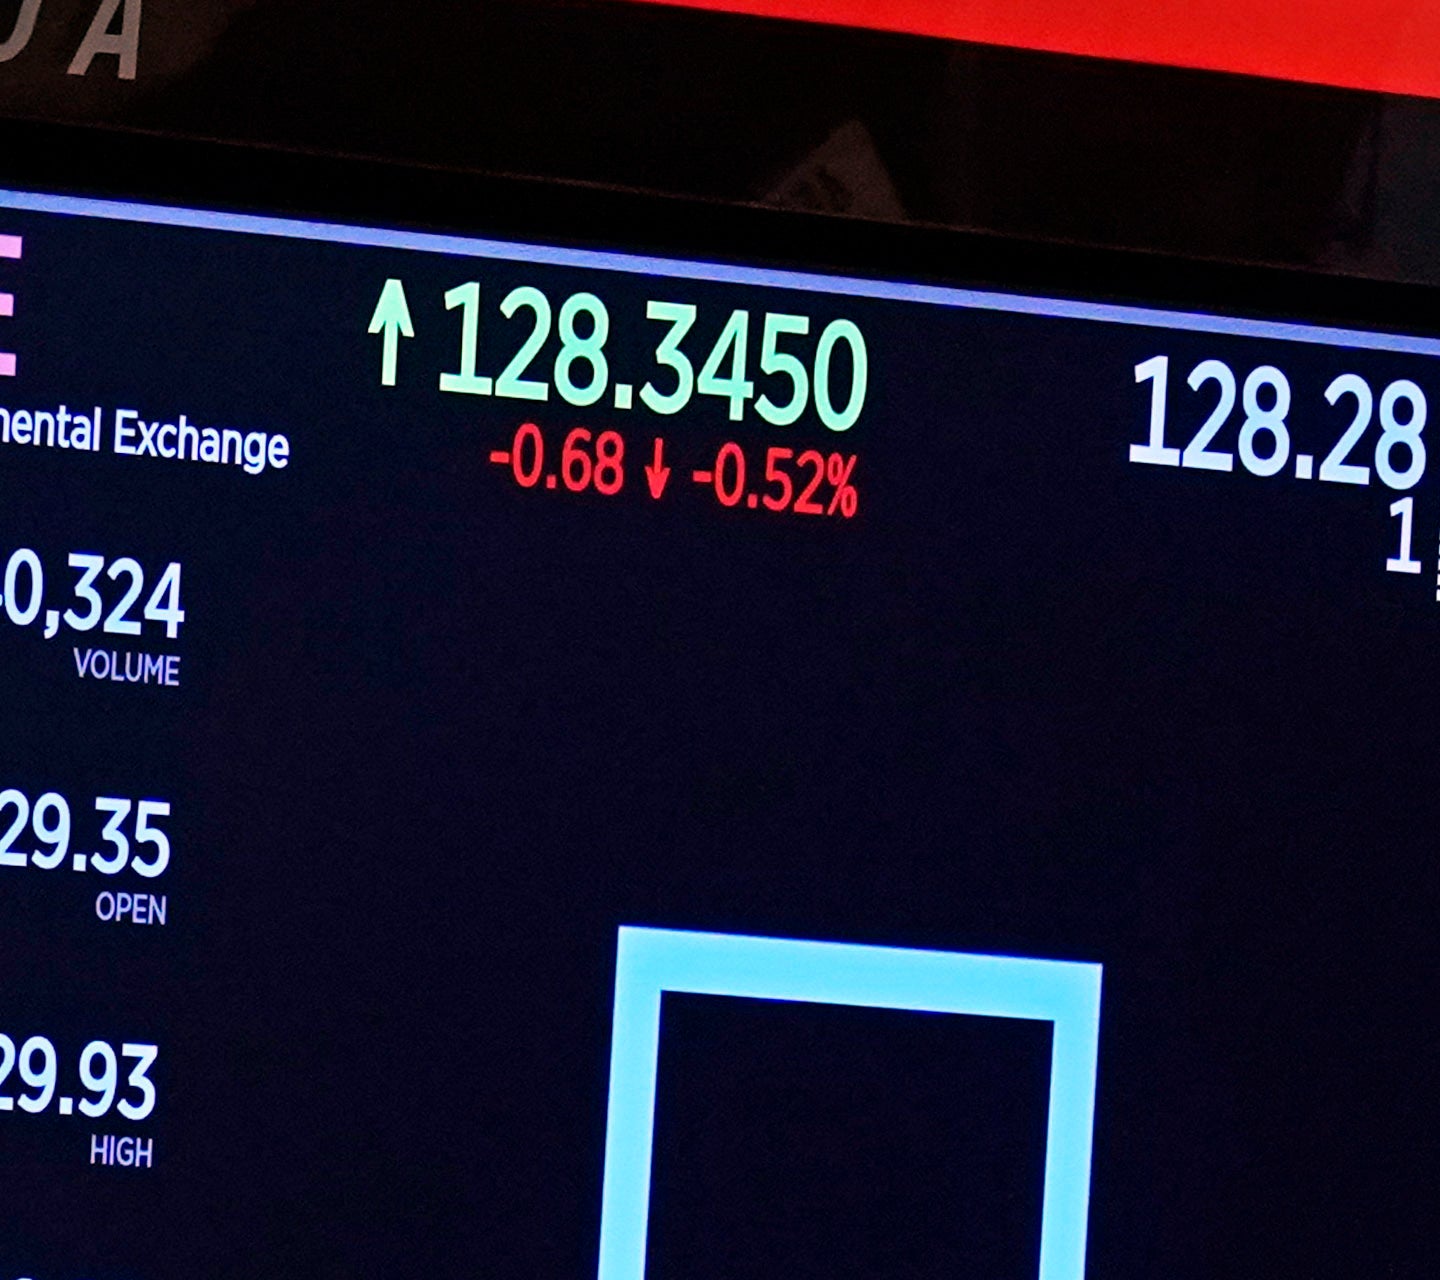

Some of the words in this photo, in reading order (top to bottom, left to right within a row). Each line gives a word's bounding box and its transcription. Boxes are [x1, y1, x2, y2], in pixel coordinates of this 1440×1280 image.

[439, 281, 869, 432] 128.3450
[0, 405, 101, 451] ental
[114, 409, 289, 475] Exchange
[1129, 355, 1427, 490] 128.28
[490, 423, 625, 495] -0.68
[692, 442, 859, 519] -0.52%
[1386, 497, 1422, 573] 1
[73, 648, 181, 686] VOLUME
[95, 891, 167, 926] OPEN
[89, 1134, 153, 1169] HIGH
